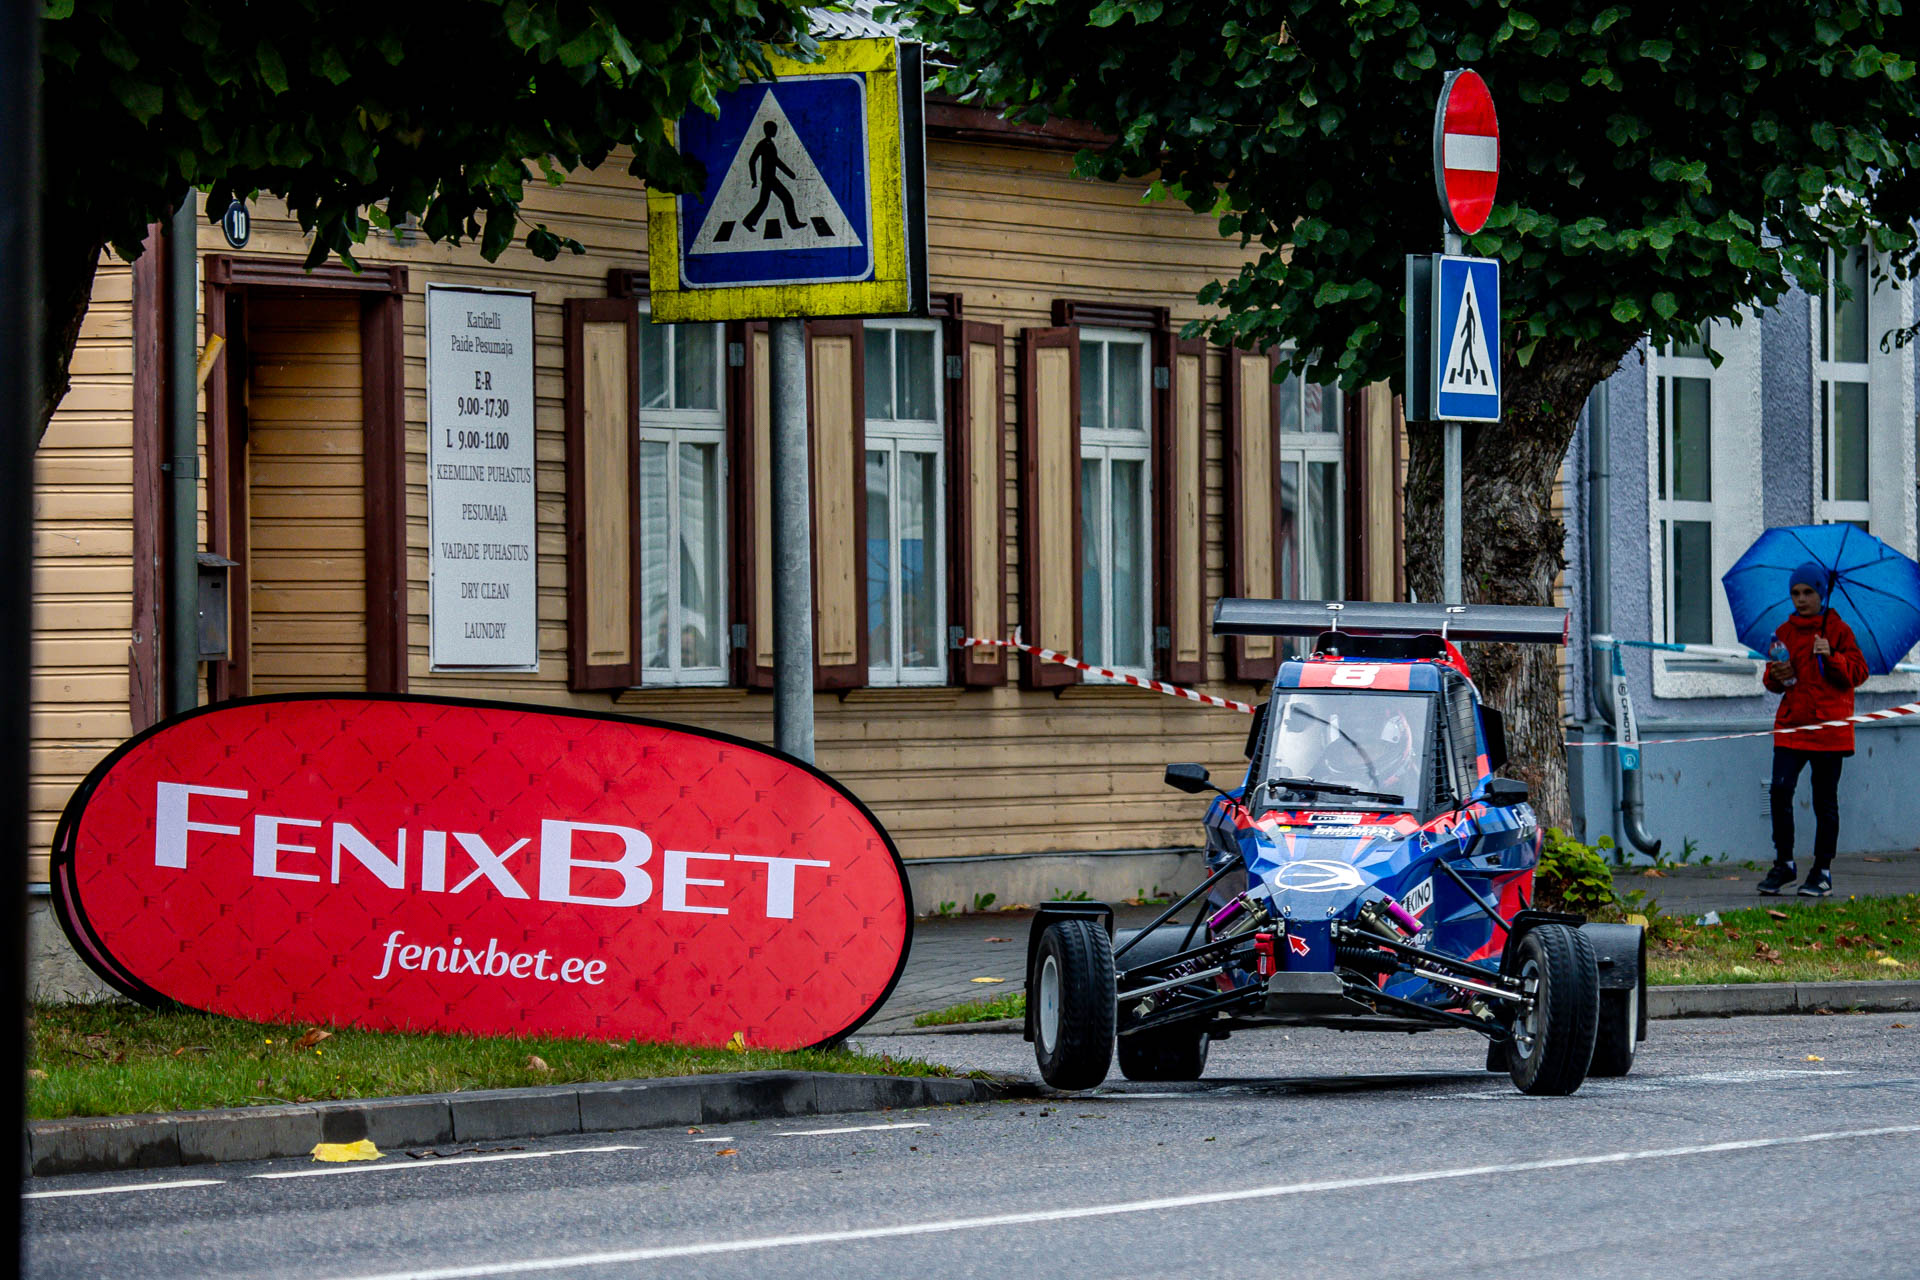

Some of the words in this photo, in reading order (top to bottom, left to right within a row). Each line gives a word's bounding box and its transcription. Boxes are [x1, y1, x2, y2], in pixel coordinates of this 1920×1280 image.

[233, 210, 246, 240] 10
[450, 334, 474, 353] Paide
[475, 337, 514, 358] Pesumaja
[474, 370, 493, 391] E-R
[457, 396, 510, 419] 9.00-17.30
[445, 428, 454, 449] L
[458, 430, 510, 451] 9.00-11.00
[436, 463, 485, 482] KEEMILINE
[487, 465, 532, 484] PUHASTUS
[461, 503, 508, 524] PESUMAJA
[441, 542, 480, 560] VAIPADE
[482, 543, 529, 562] PUHASTUS
[460, 582, 479, 600] DRY
[480, 582, 510, 600] CLEAN
[464, 622, 507, 640] LAUNDRY
[1330, 665, 1380, 687] 8
[372, 930, 608, 985] fenixbet.ee
